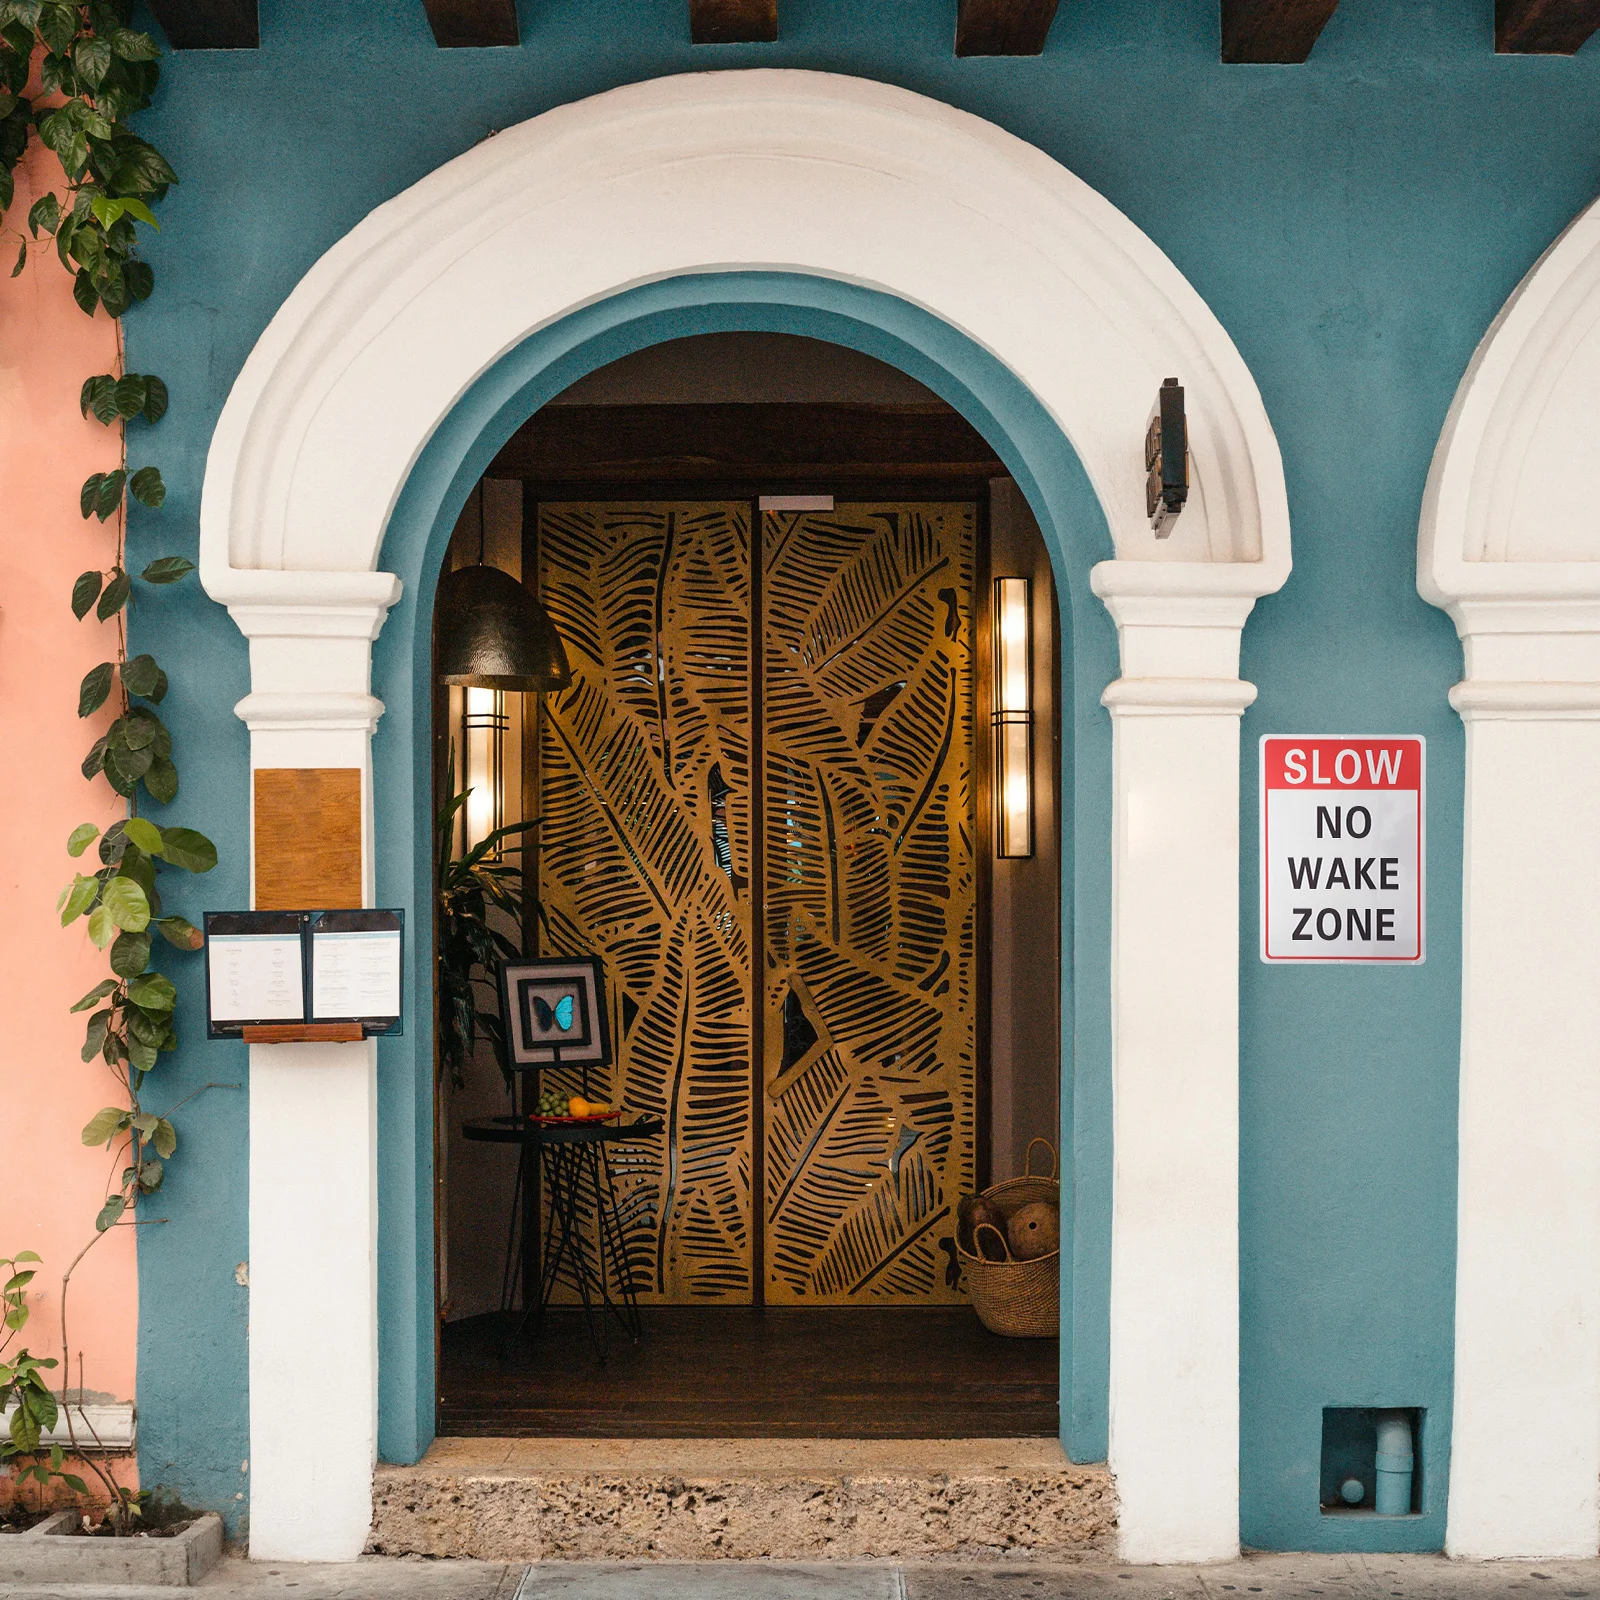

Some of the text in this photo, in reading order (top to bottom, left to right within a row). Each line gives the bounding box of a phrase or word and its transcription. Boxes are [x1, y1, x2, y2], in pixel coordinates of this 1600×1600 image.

[1284, 748, 1403, 785] SLOW
[1316, 805, 1372, 839] NO
[1288, 857, 1399, 890] WAKE
[1291, 907, 1395, 941] ZONE
